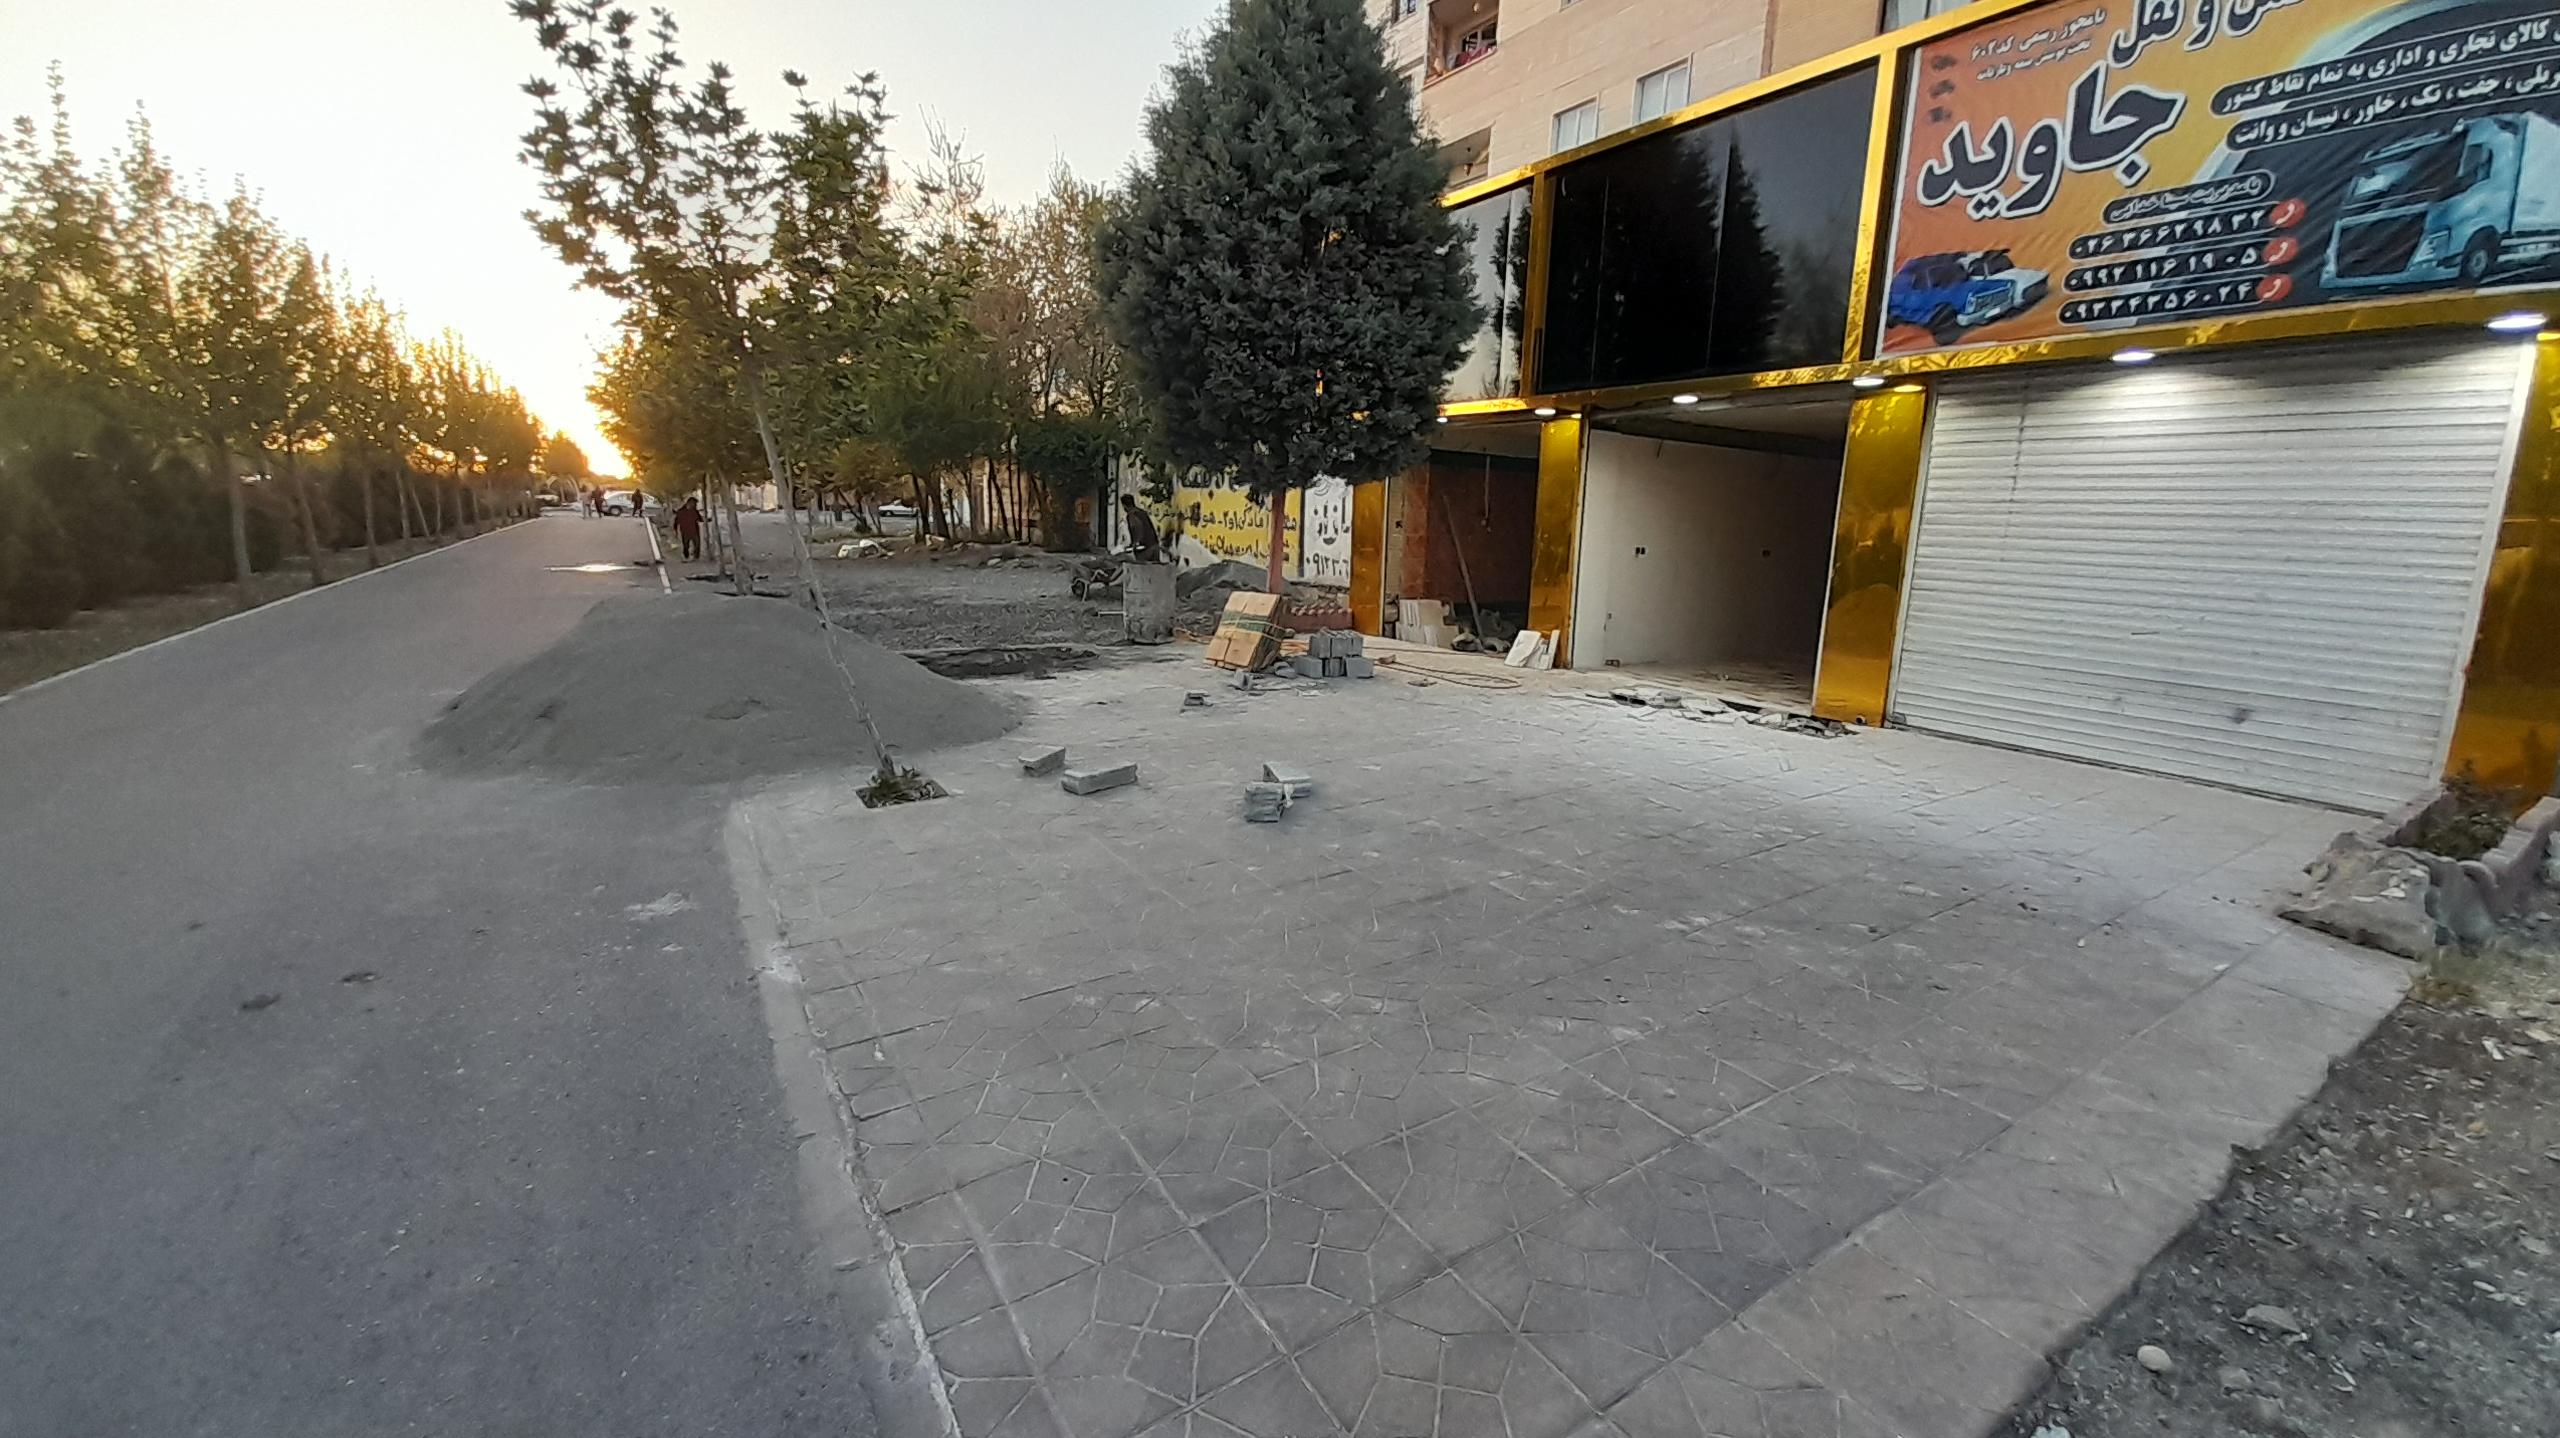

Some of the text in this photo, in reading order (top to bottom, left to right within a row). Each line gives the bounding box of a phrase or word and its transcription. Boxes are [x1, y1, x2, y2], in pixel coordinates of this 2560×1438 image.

[2439, 31, 2496, 63] تجاری
[2499, 18, 2550, 51] کالای
[2347, 61, 2365, 78] به
[2368, 45, 2421, 79] اداری
[2424, 49, 2435, 66] و
[2268, 72, 2304, 96] نقاط
[2307, 66, 2343, 94] تمام
[2456, 74, 2499, 99] جفت
[2222, 81, 2264, 113] کشور
[2352, 94, 2396, 125] خاور
[2234, 120, 2275, 143] وانت
[2277, 121, 2288, 141] و
[2291, 107, 2340, 137] نیسان
[1917, 60, 2187, 221] جاوید
